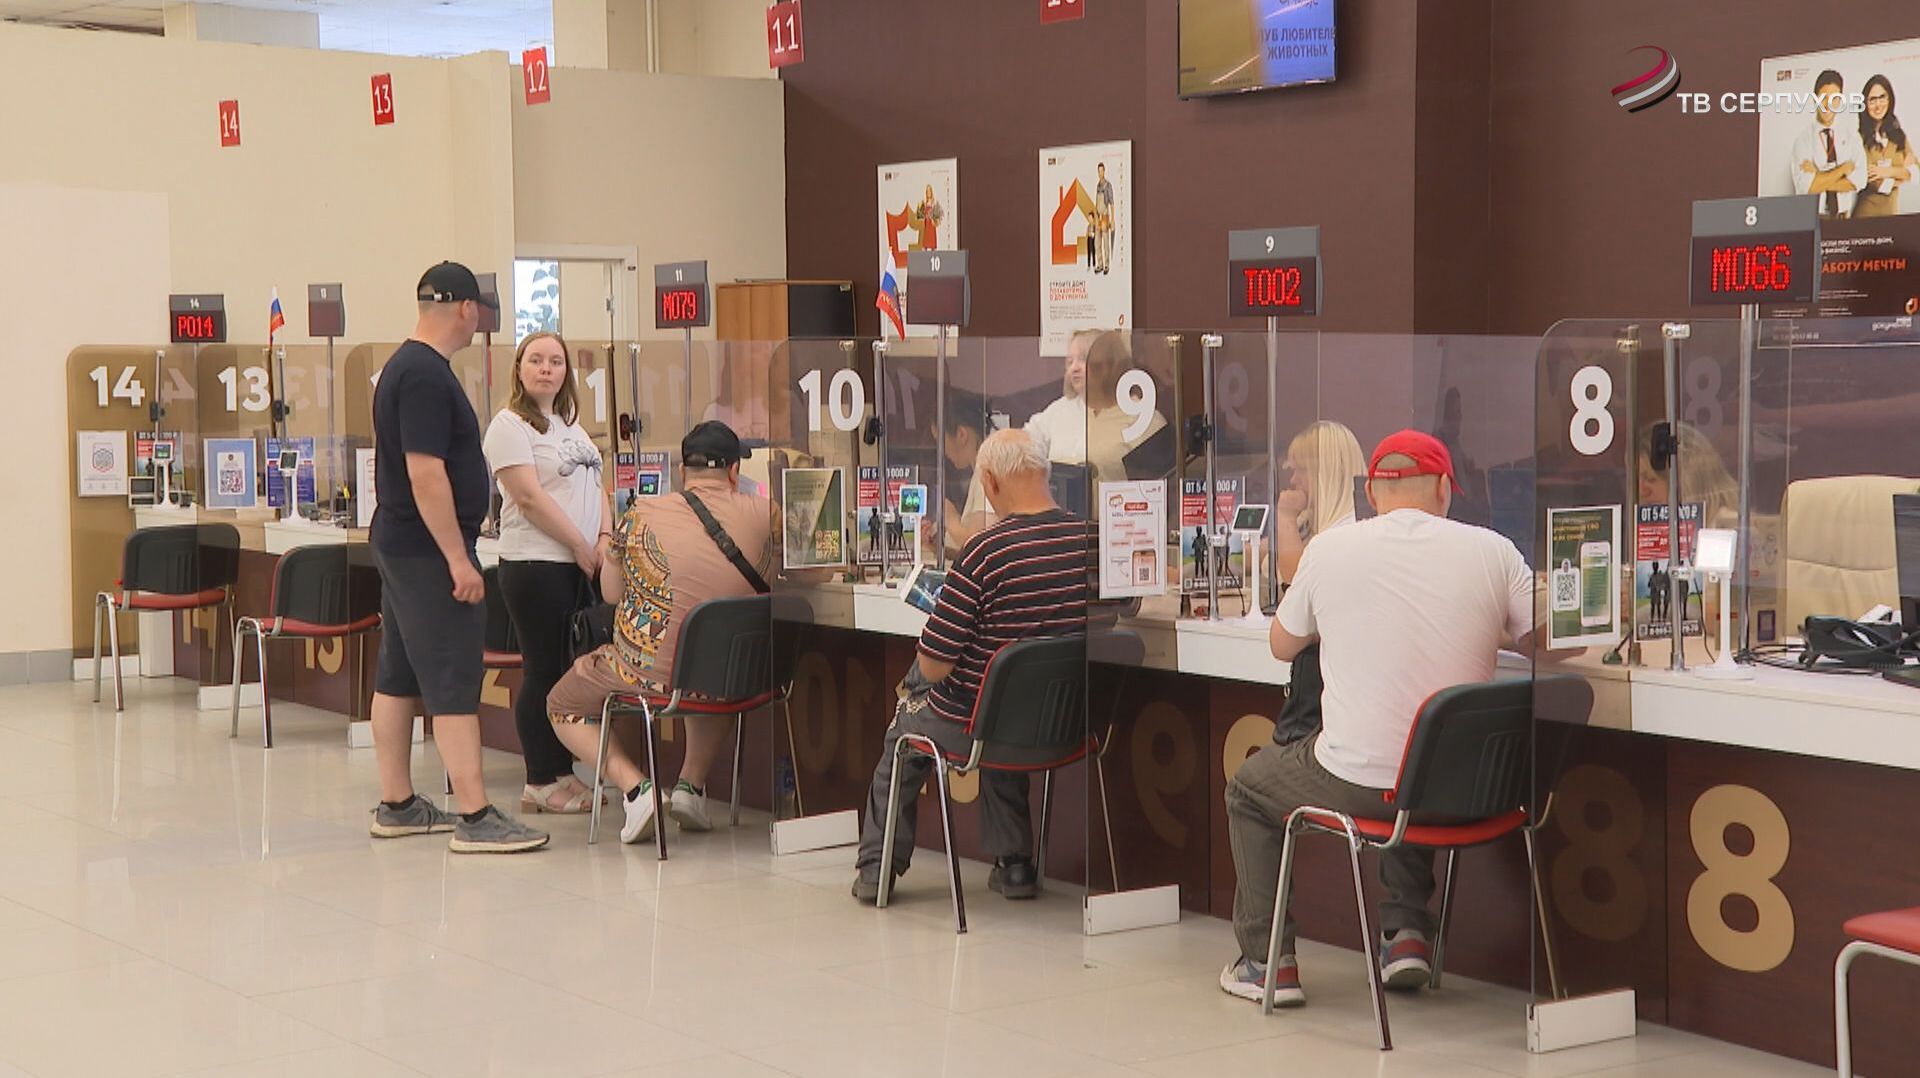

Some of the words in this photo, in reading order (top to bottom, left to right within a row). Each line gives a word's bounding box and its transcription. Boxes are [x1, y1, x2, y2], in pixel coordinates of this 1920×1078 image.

[772, 14, 799, 54] 11
[1267, 45, 1329, 60] ЖИВОТНЫХ
[527, 60, 547, 93] 12
[374, 84, 391, 115] 13
[222, 110, 238, 138] 14
[1745, 206, 1758, 225] 8
[1265, 235, 1275, 253] 9
[675, 268, 683, 282] 11
[930, 256, 941, 272] 10
[1822, 261, 1861, 272] АБОТУ
[1863, 259, 1906, 271] МЕЧТЫ
[89, 366, 145, 407] 14
[217, 366, 271, 411] 13
[798, 368, 865, 432] 10
[1116, 369, 1157, 443] 9
[1569, 365, 1615, 455] 8
[862, 468, 871, 479] ОТ
[1185, 481, 1195, 493] ОТ
[1641, 506, 1651, 521] ОТ
[1652, 506, 1659, 520] 5
[1686, 783, 1795, 963] 8
